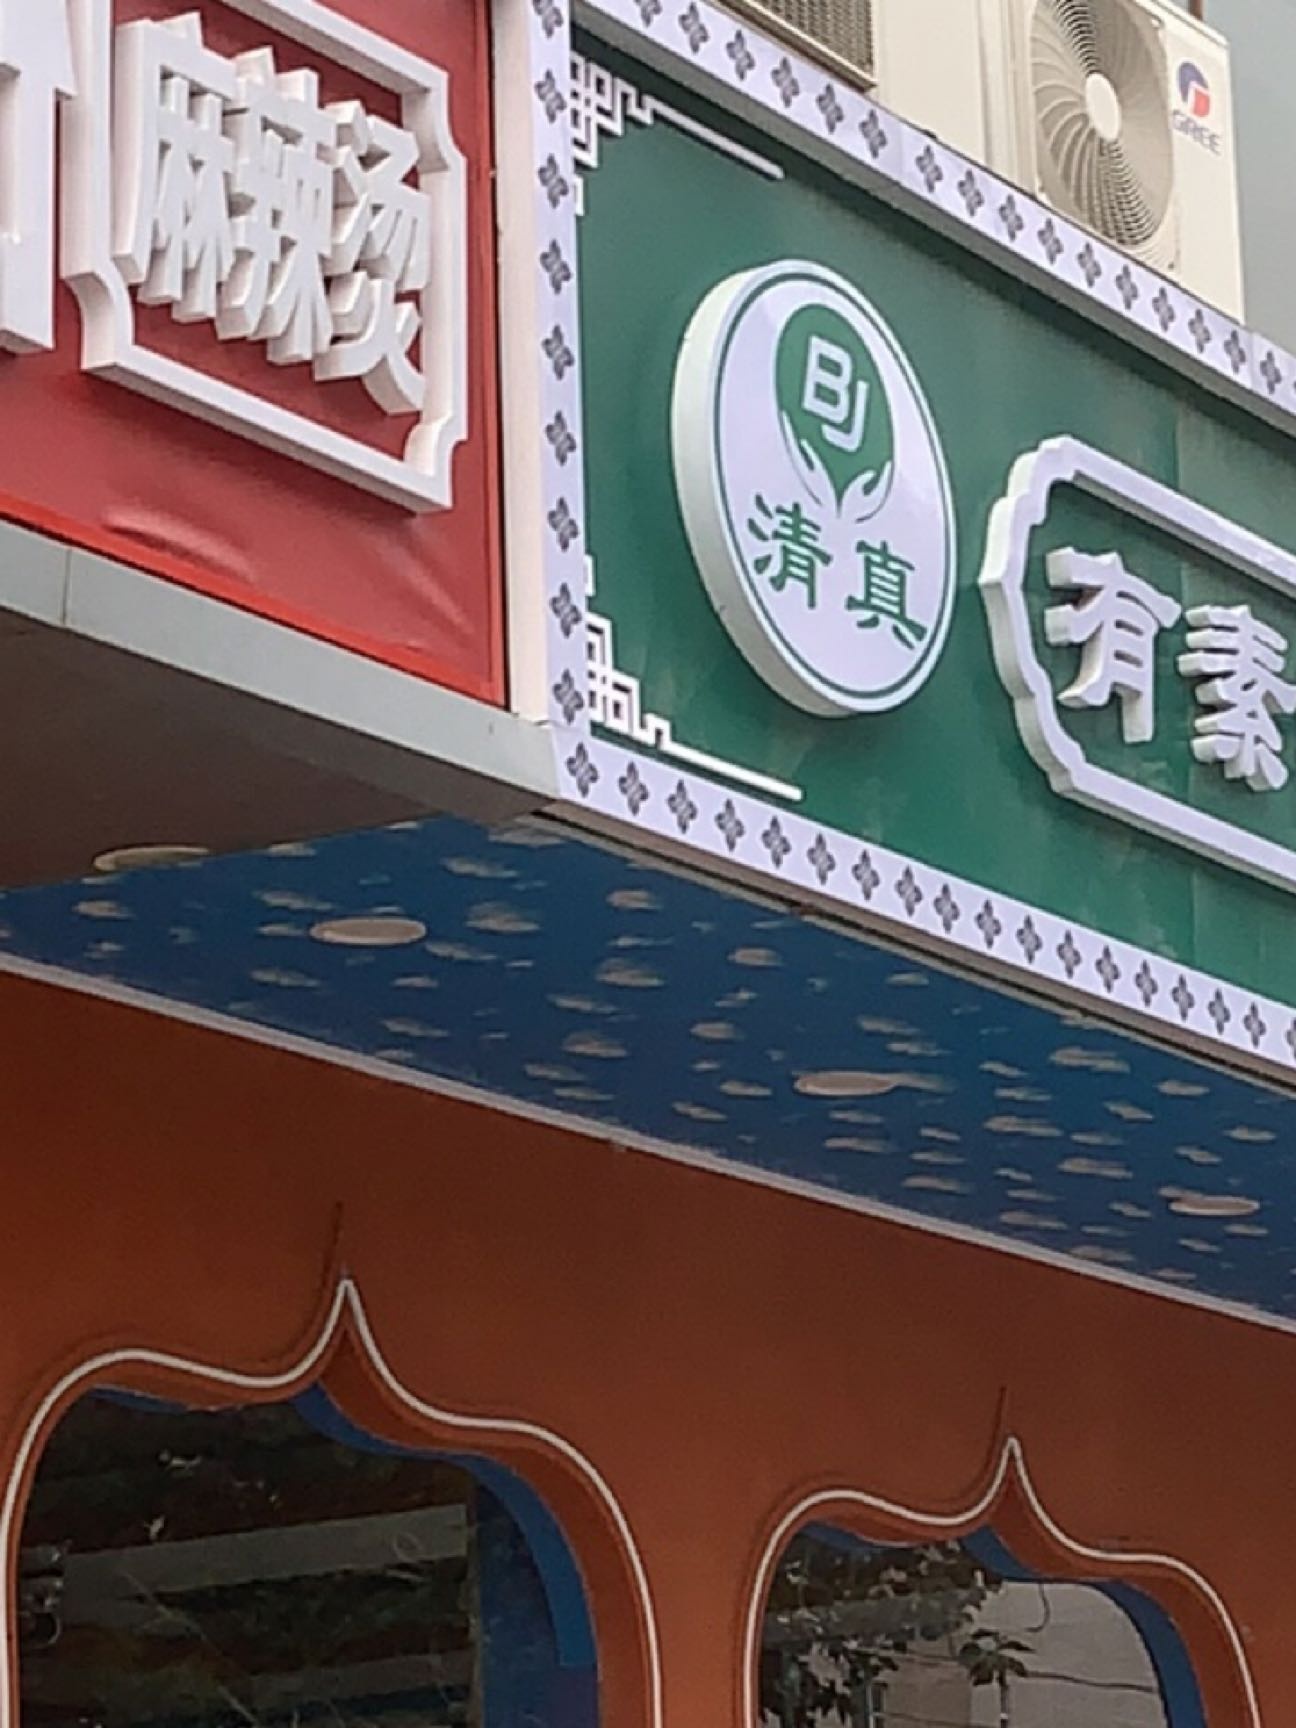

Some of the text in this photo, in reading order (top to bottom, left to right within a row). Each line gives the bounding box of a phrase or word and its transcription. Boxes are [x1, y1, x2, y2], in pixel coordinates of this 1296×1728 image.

[112, 12, 431, 416] 麻辣烫
[747, 494, 928, 651] 清真
